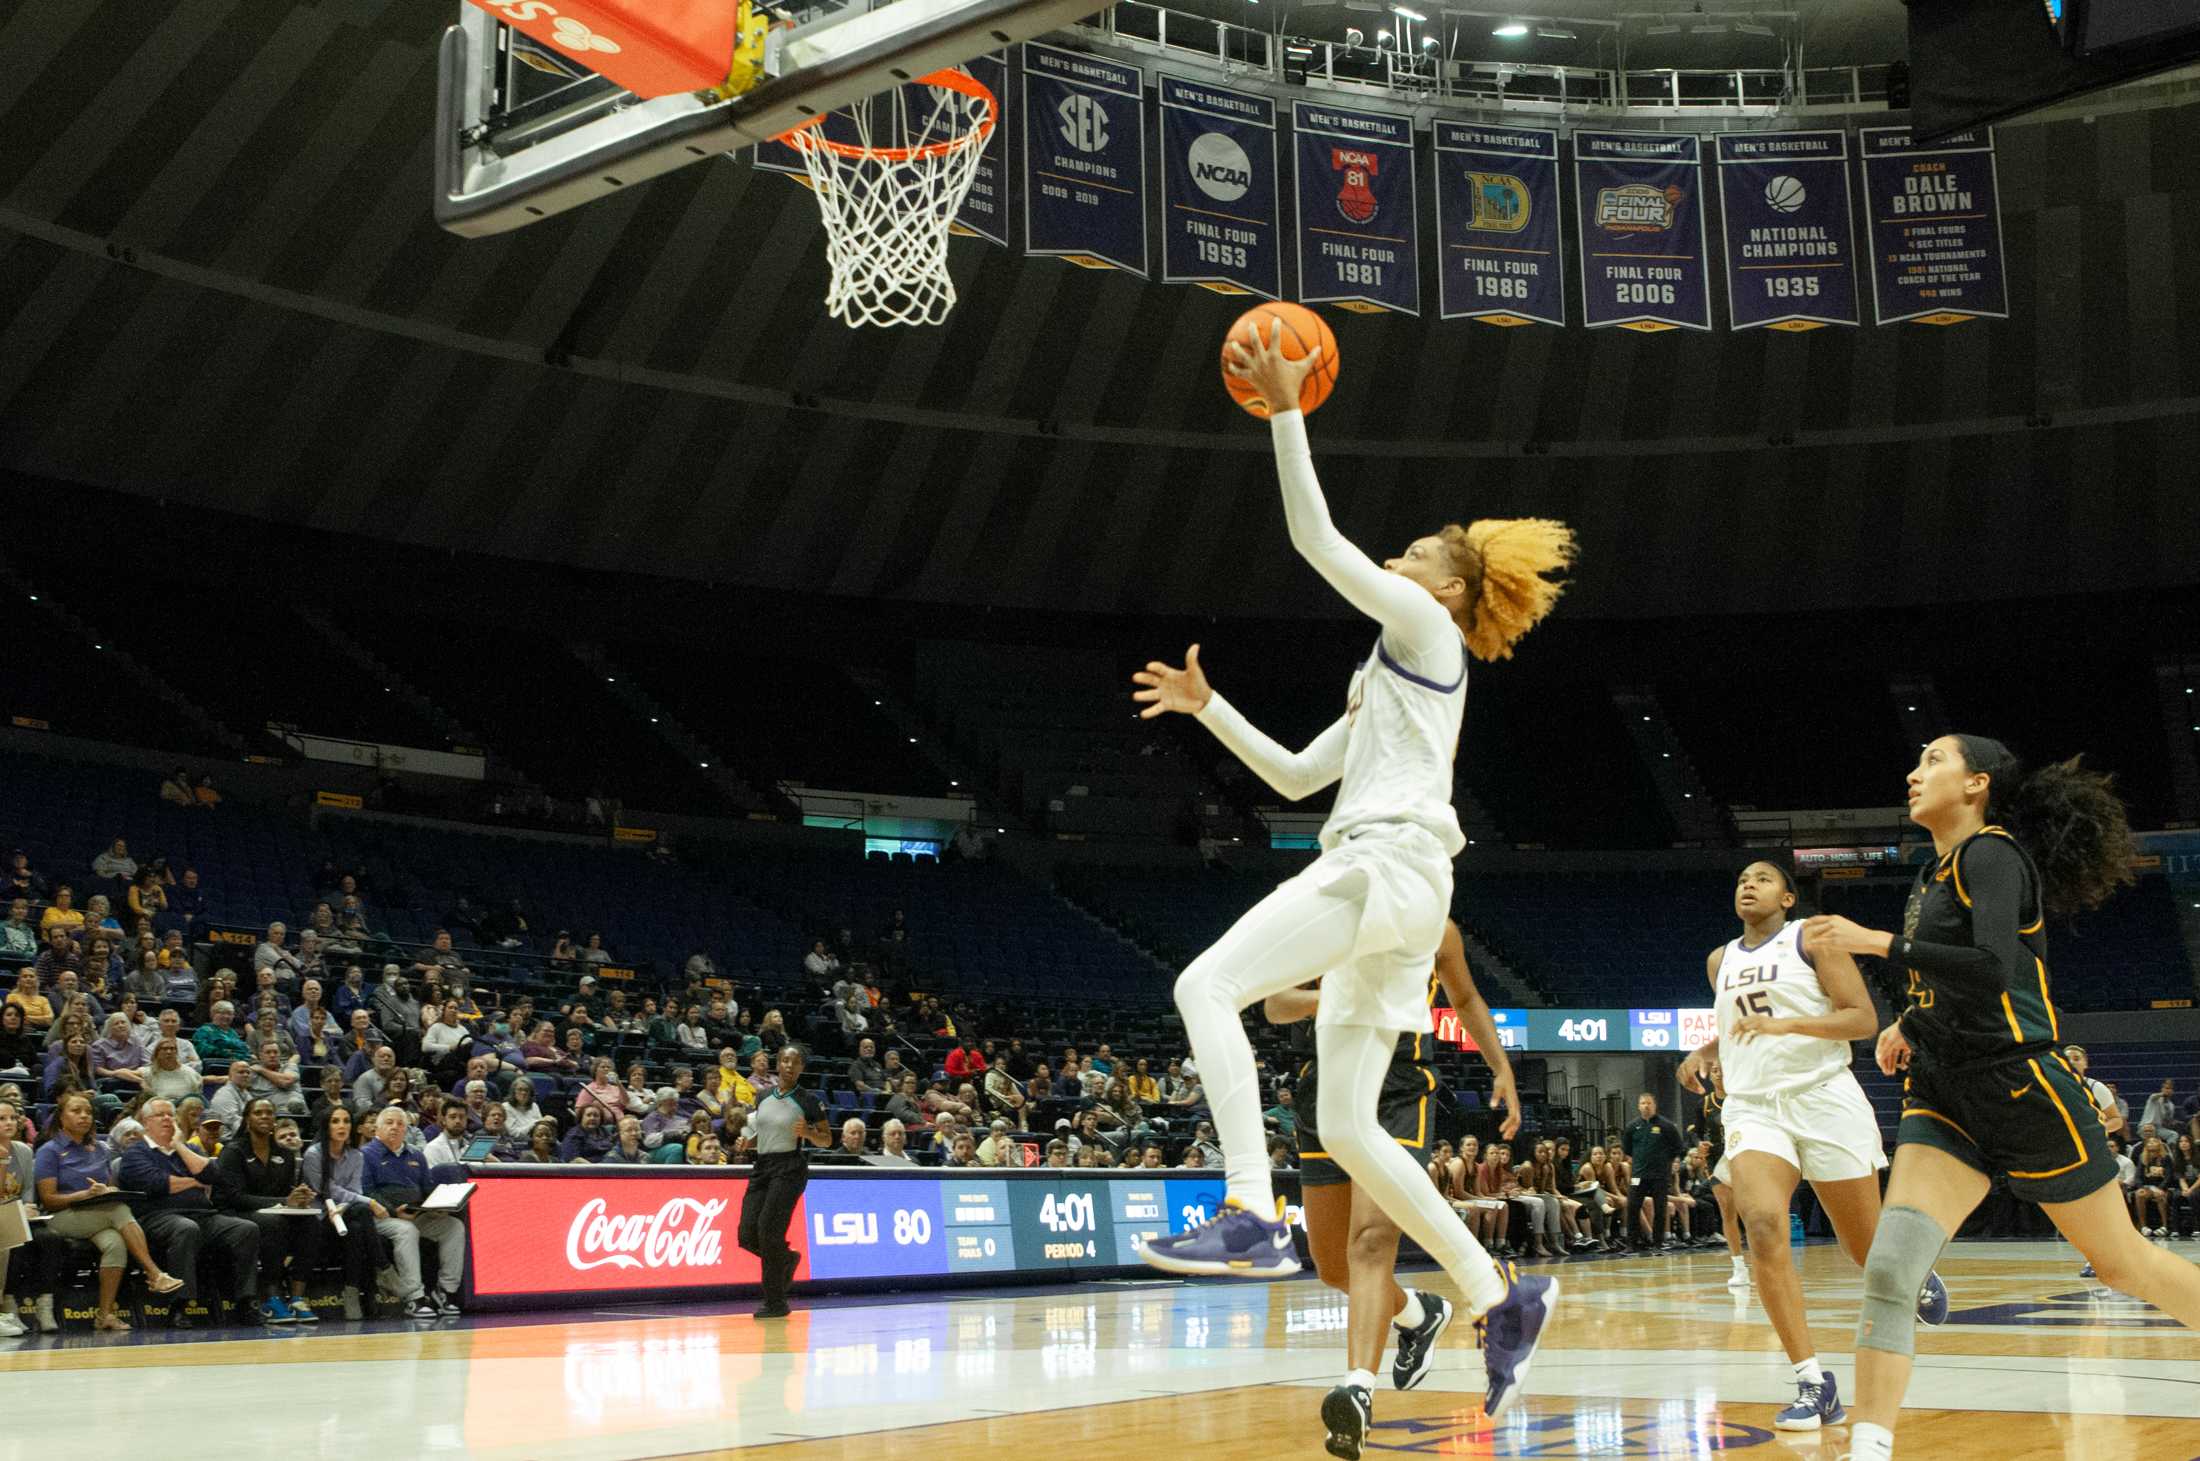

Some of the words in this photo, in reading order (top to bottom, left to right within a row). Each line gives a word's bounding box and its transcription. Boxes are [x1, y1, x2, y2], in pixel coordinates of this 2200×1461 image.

[1039, 54, 1070, 71] MEN'S
[1072, 64, 1127, 85] BASKETBALL
[1175, 87, 1205, 103] MEN'S
[1206, 93, 1260, 116] BASKETBALL
[1057, 94, 1110, 152] SEC
[1310, 112, 1339, 127] MEN'S
[1341, 118, 1397, 136] BASKETBALL
[1451, 131, 1482, 143] MEN'S
[1483, 134, 1541, 149] BASKETBALL
[1591, 141, 1623, 152] MEN'S
[1625, 143, 1682, 154] BASKETBALL
[1735, 142, 1766, 153] MEN'S
[1768, 140, 1829, 152] BASKETBALL
[1879, 136, 1911, 147] MEN'S
[1054, 155, 1117, 179] CHAMPIONS
[1338, 151, 1370, 167] NCAA
[1912, 162, 1947, 173] COACH
[1196, 162, 1249, 188] NCAA
[1347, 170, 1364, 187] 81
[1904, 174, 1959, 195] DALE
[1075, 191, 1099, 206] 2019
[1619, 196, 1665, 207] FINAL
[1893, 191, 1973, 214] BROWN
[1602, 206, 1665, 221] FOUR
[1186, 220, 1221, 239] FINAL
[1225, 229, 1257, 246] FOUR
[1750, 226, 1828, 242] NATIONAL
[1911, 227, 1936, 236] FINAL
[1937, 225, 1967, 235] FOURS
[1322, 242, 1360, 260] FINAL
[1361, 248, 1395, 264] FOUR
[1742, 242, 1838, 258] CHAMPIONS
[1916, 239, 1934, 249] SEC
[1935, 238, 1964, 248] TITLES
[1198, 240, 1247, 269] 1953
[1899, 252, 1922, 262] NCAA
[1923, 249, 1987, 262] TOURNAMENTS
[1336, 261, 1382, 287] 1981
[1464, 258, 1501, 274] FINAL
[1504, 261, 1539, 276] FOUR
[1606, 267, 1645, 280] FINAL
[1647, 267, 1682, 281] FOUR
[1928, 263, 1969, 273] NATIONAL
[1475, 275, 1528, 299] 1986
[1765, 276, 1819, 298] 1935
[1897, 275, 1926, 285] COACH
[1927, 274, 1938, 283] OF
[1940, 273, 1957, 283] THE
[1959, 272, 1981, 282] YEAR
[1616, 283, 1675, 304] 2006
[1938, 287, 1962, 298] WINS
[1863, 851, 1884, 861] LIFE
[1724, 964, 1778, 992] LSU
[1735, 991, 1774, 1018] 15
[1638, 1011, 1672, 1025] LSU
[1558, 1018, 1607, 1041] 4:01
[1641, 1028, 1670, 1047] 80
[1039, 1192, 1096, 1232] 4:01
[1182, 1205, 1207, 1232] 31
[566, 1197, 729, 1270] Coca-Cola
[814, 1212, 878, 1245] LSU
[894, 1208, 931, 1245] 80
[984, 1238, 996, 1257] 0
[1044, 1243, 1084, 1259] PERIOD
[1086, 1240, 1096, 1258] 4
[1130, 1234, 1140, 1251] 3
